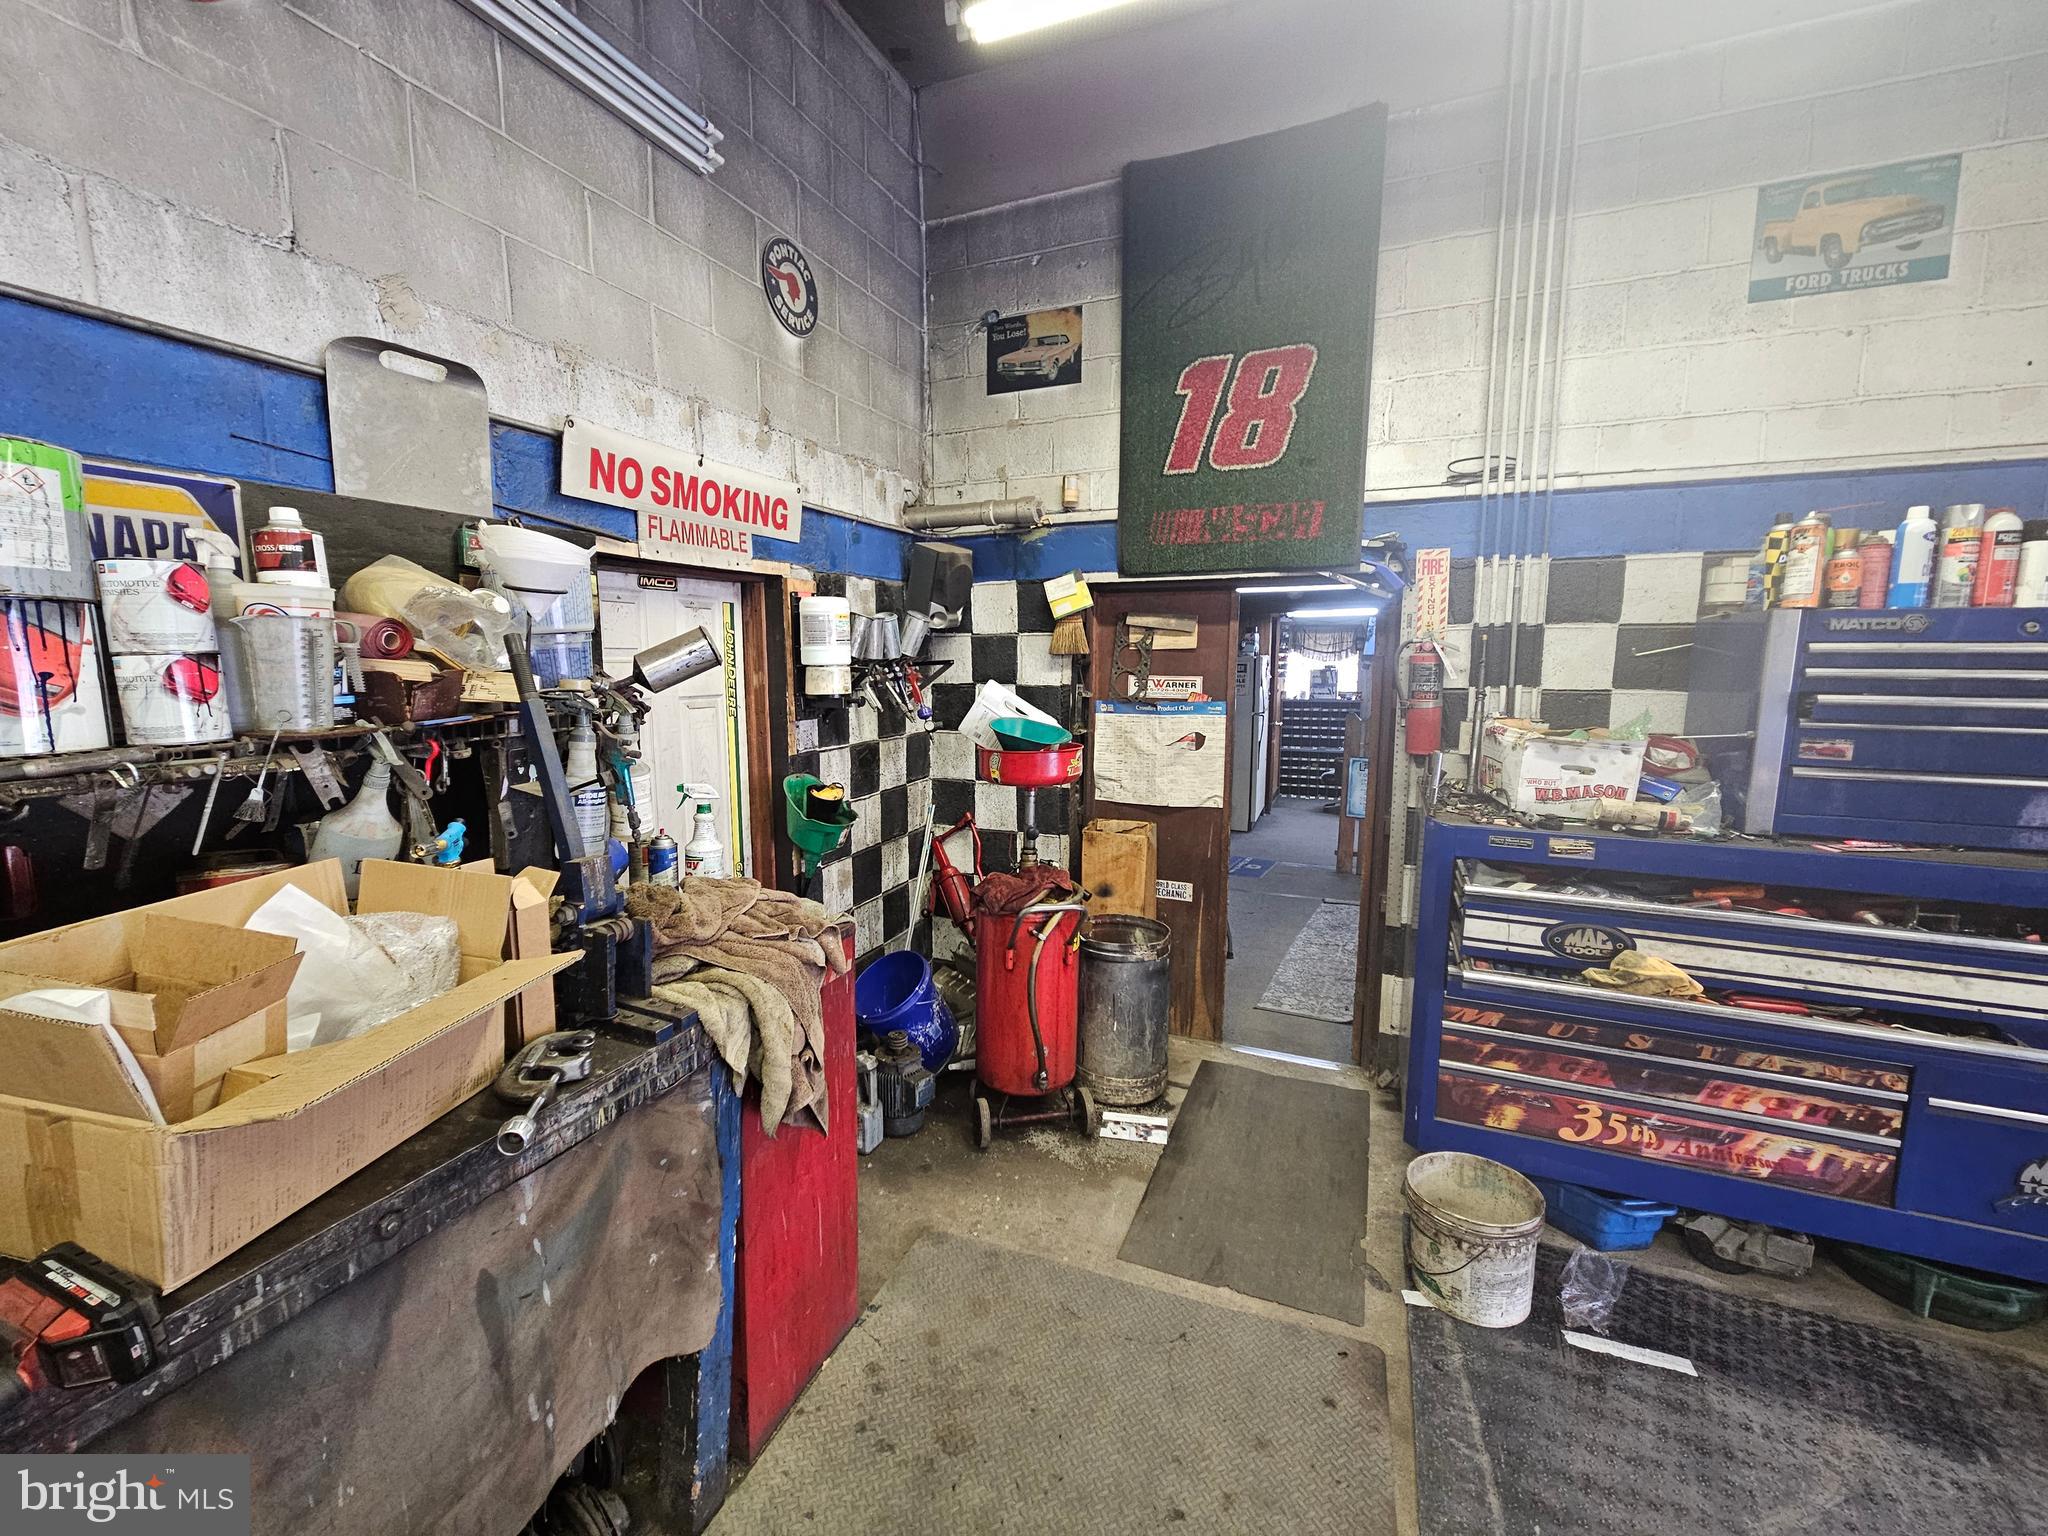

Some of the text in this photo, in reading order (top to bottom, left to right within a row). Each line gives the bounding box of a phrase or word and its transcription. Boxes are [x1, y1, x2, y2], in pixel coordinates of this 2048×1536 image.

[768, 243, 812, 282] PONTIAC
[1785, 272, 1832, 291] FORD
[1840, 262, 1910, 284] TRUCKS
[774, 295, 814, 331] SERVICE
[1162, 342, 1318, 475] 18
[589, 447, 788, 532] NO SMOKING
[87, 512, 198, 561] NAPA
[647, 514, 748, 553] FLAMMABLE
[640, 577, 676, 588] IMCO
[1421, 558, 1445, 576] FIRE
[1427, 576, 1437, 632] EXTINGUI
[1829, 617, 1902, 631] MATCO
[725, 622, 738, 718] JOHN DEERE
[1152, 679, 1197, 689] WARNER
[1156, 881, 1187, 891] ORLD CLASS
[1156, 888, 1187, 899] ECHANIC
[1564, 928, 1614, 951] MAC
[1558, 1103, 1657, 1146] 35th
